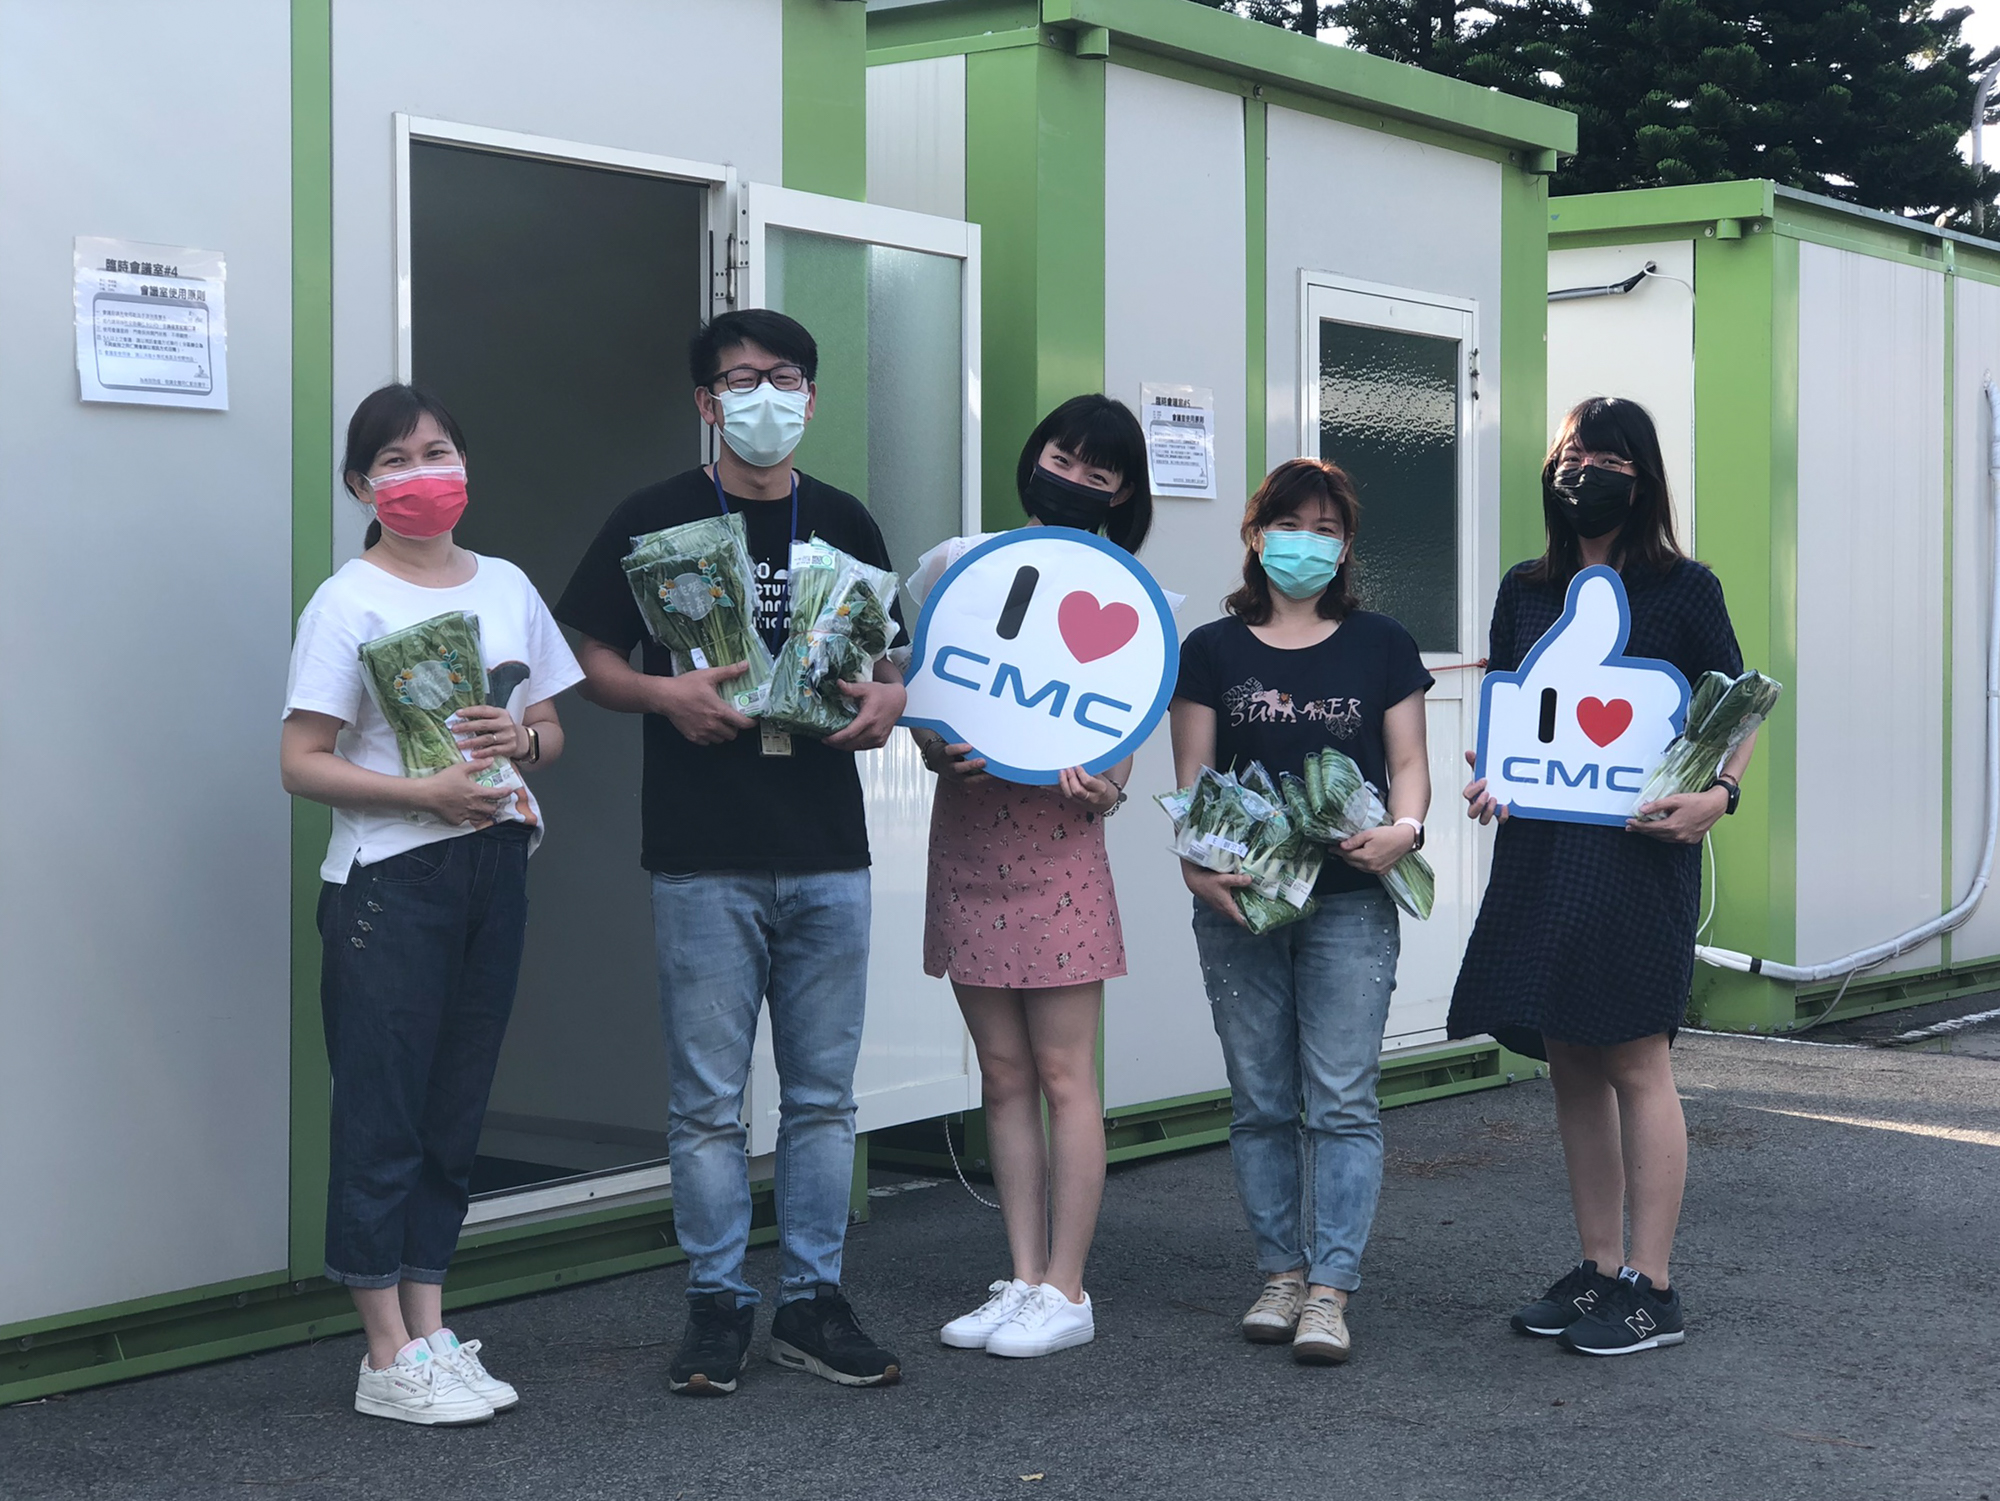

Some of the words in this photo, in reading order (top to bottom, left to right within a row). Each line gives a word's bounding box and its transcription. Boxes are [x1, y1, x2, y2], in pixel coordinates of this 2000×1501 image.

[105, 258, 178, 278] 臨時會議室#4
[140, 284, 206, 302] 會議室使用原則
[996, 565, 1040, 640] I
[932, 645, 1132, 739] CMC
[1538, 687, 1558, 744] I
[1502, 756, 1644, 793] CMC
